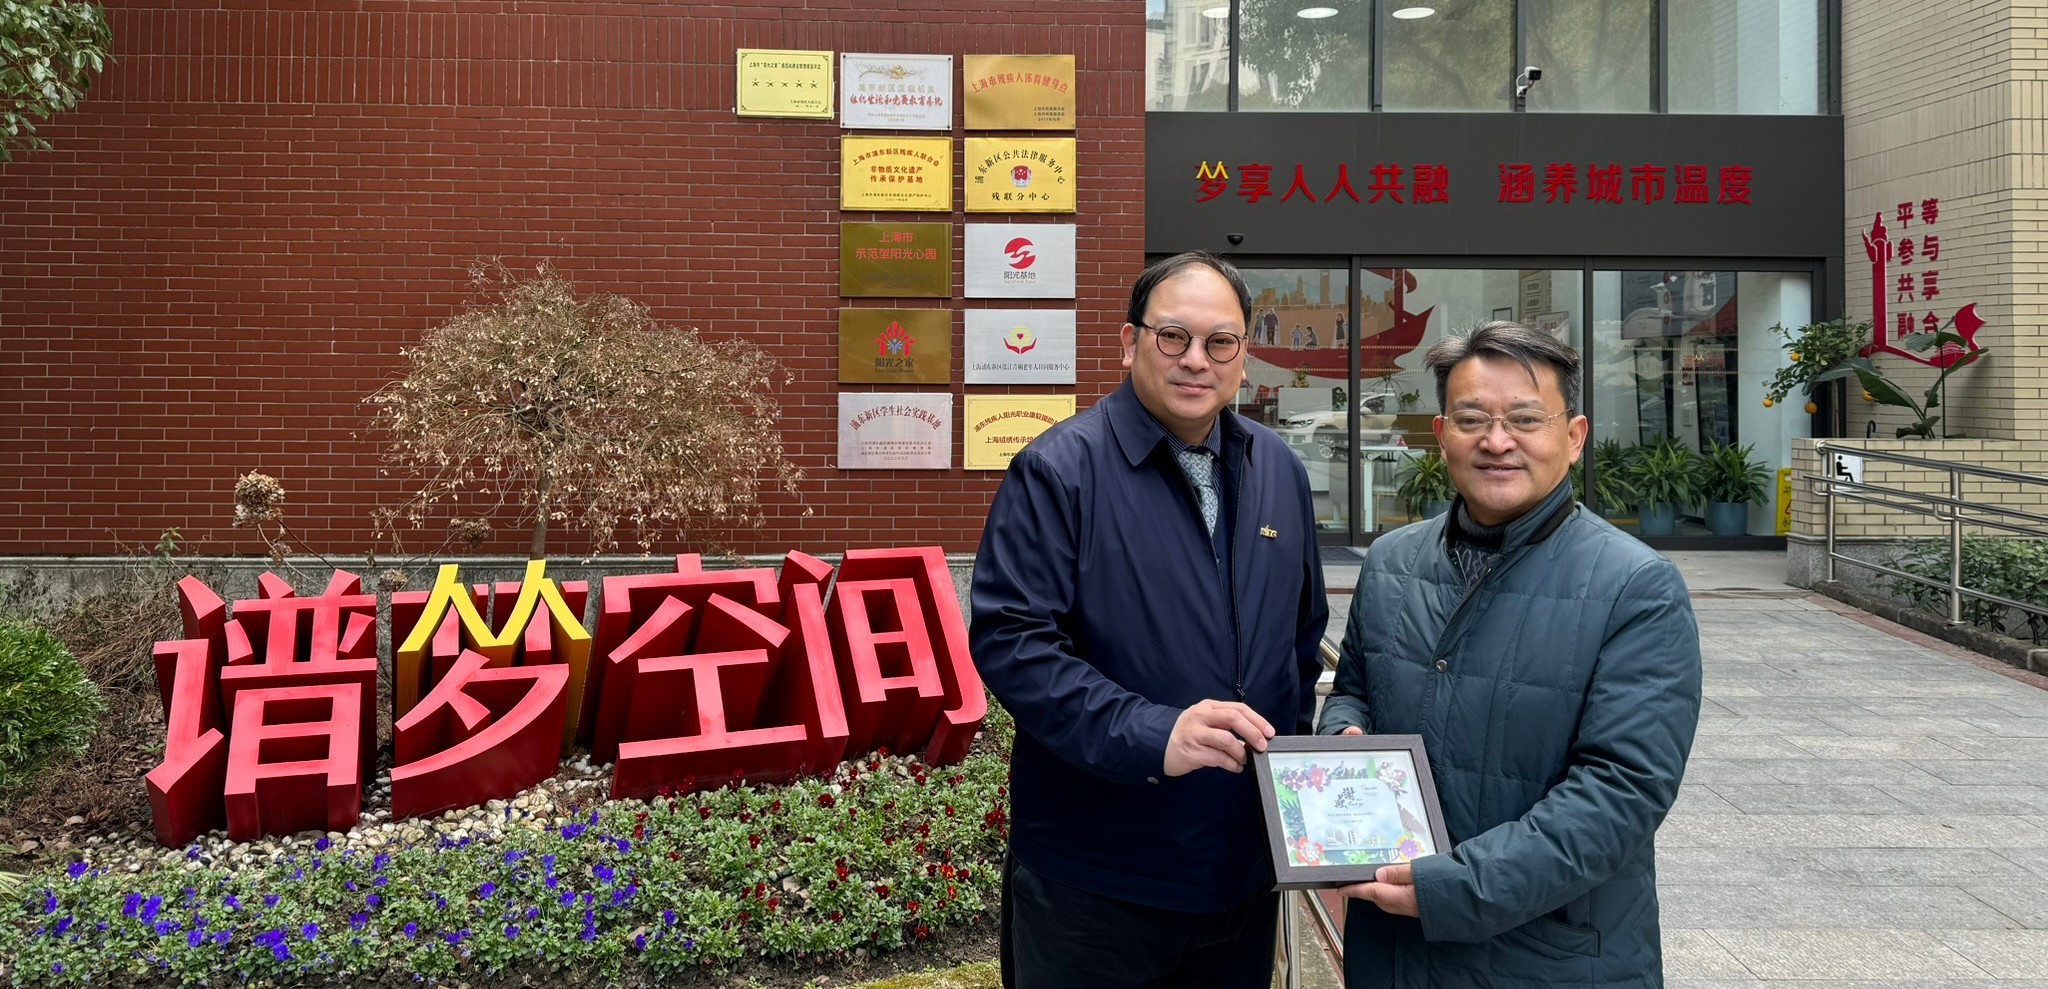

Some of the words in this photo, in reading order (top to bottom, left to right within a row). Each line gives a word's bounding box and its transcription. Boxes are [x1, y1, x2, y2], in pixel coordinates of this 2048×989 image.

[971, 72, 1069, 94] 上海市残疾人体育健身点
[853, 148, 940, 167] 上海市浦东新区残疾人联合会
[870, 165, 923, 174] 非物质文化遗产
[974, 149, 1065, 184] 浦东新区公共法律服务中心
[870, 175, 923, 183] 传承保护基地
[1195, 161, 1450, 204] 梦享人人共融
[1498, 162, 1754, 205] 涵养城市温度
[991, 192, 1050, 201] 残联分中心
[879, 231, 914, 243] 上海市
[855, 247, 937, 259] 示范型阳光心园
[1003, 271, 1036, 279] 阳光基地
[875, 358, 914, 367] 阳光之家
[849, 405, 942, 431] 浦东新区学生社会实践基地
[145, 546, 986, 840] 谱梦空间
